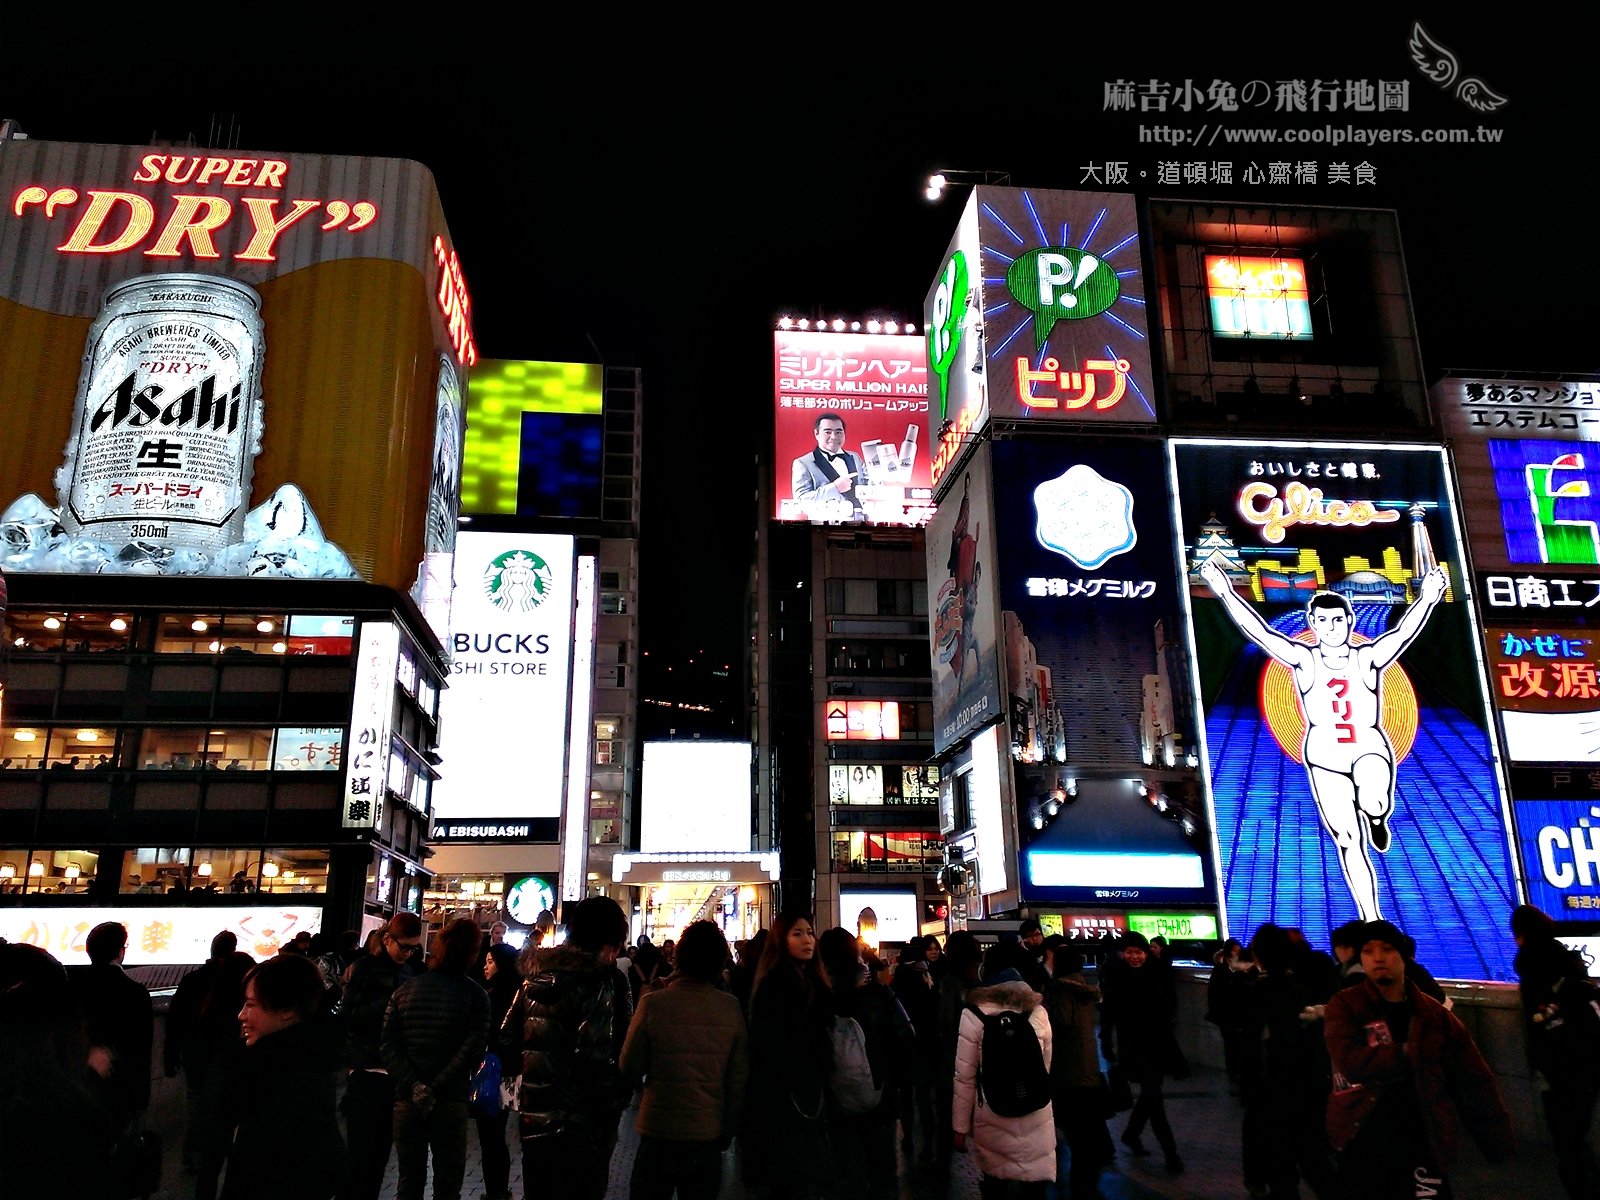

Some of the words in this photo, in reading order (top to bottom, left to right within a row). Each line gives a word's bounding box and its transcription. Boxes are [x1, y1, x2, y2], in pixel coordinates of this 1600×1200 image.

[133, 153, 288, 189] SUPER
[1037, 251, 1099, 309] P!
[118, 334, 144, 358] ASAHI
[147, 325, 201, 339] BREWERIES
[202, 332, 231, 361] LIMITED
[779, 355, 928, 379] ミリオンヘアー
[779, 378, 832, 391] SUPER
[835, 380, 892, 394] MILLION
[1016, 356, 1131, 410] ピップ
[1464, 383, 1600, 405] 夢あるマンショ
[90, 370, 242, 437] Asahi
[1470, 409, 1600, 429] エステムコー
[136, 438, 183, 470] 生
[108, 482, 204, 499] スーパードライ
[1239, 481, 1401, 544] Glico
[130, 524, 169, 539] 350ml
[1501, 633, 1586, 657] かぜに
[490, 662, 547, 676] STORE
[1497, 661, 1600, 699] 改源
[448, 825, 529, 837] EBISUBASHI
